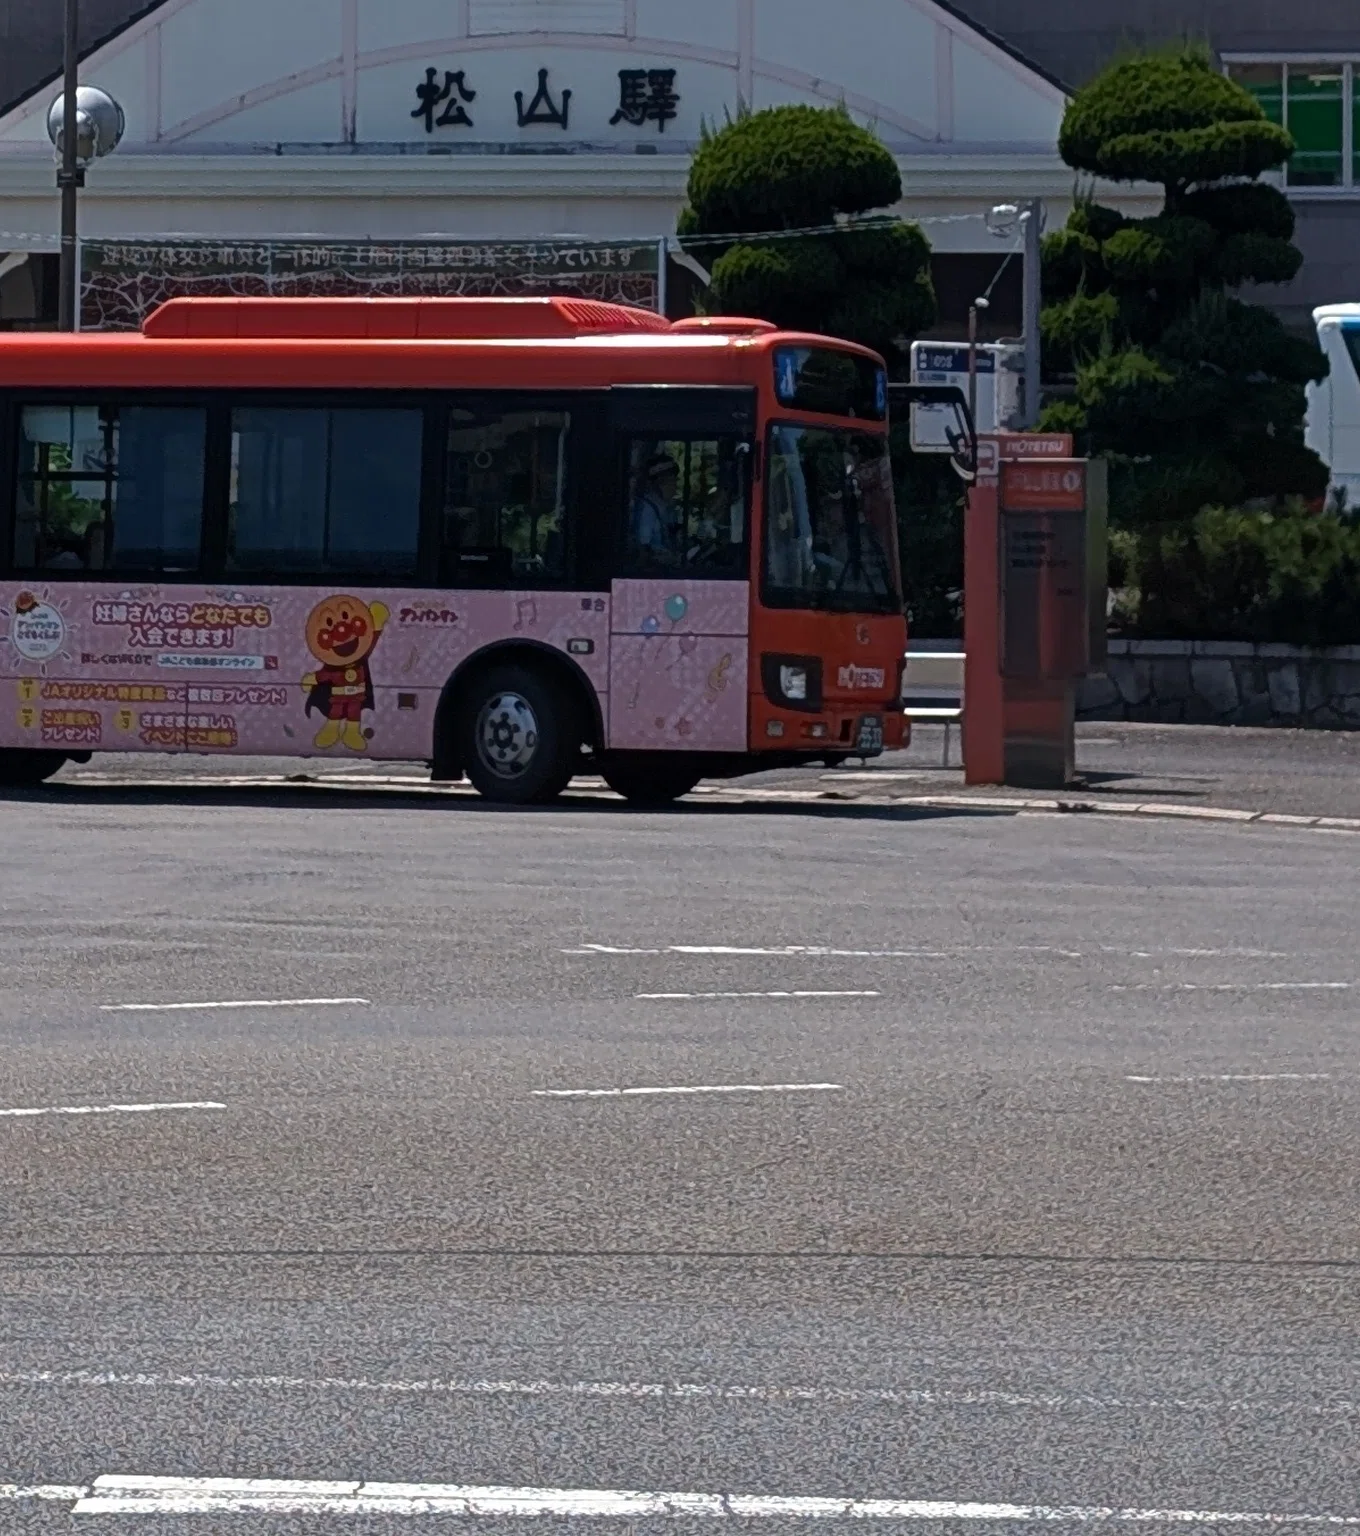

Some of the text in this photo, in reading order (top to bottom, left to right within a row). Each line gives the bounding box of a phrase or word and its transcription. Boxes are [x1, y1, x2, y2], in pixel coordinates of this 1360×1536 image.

[410, 66, 681, 134] 松山驛
[94, 602, 270, 627] 妊婦さんならどなたでも
[130, 626, 233, 648] 入会できます!
